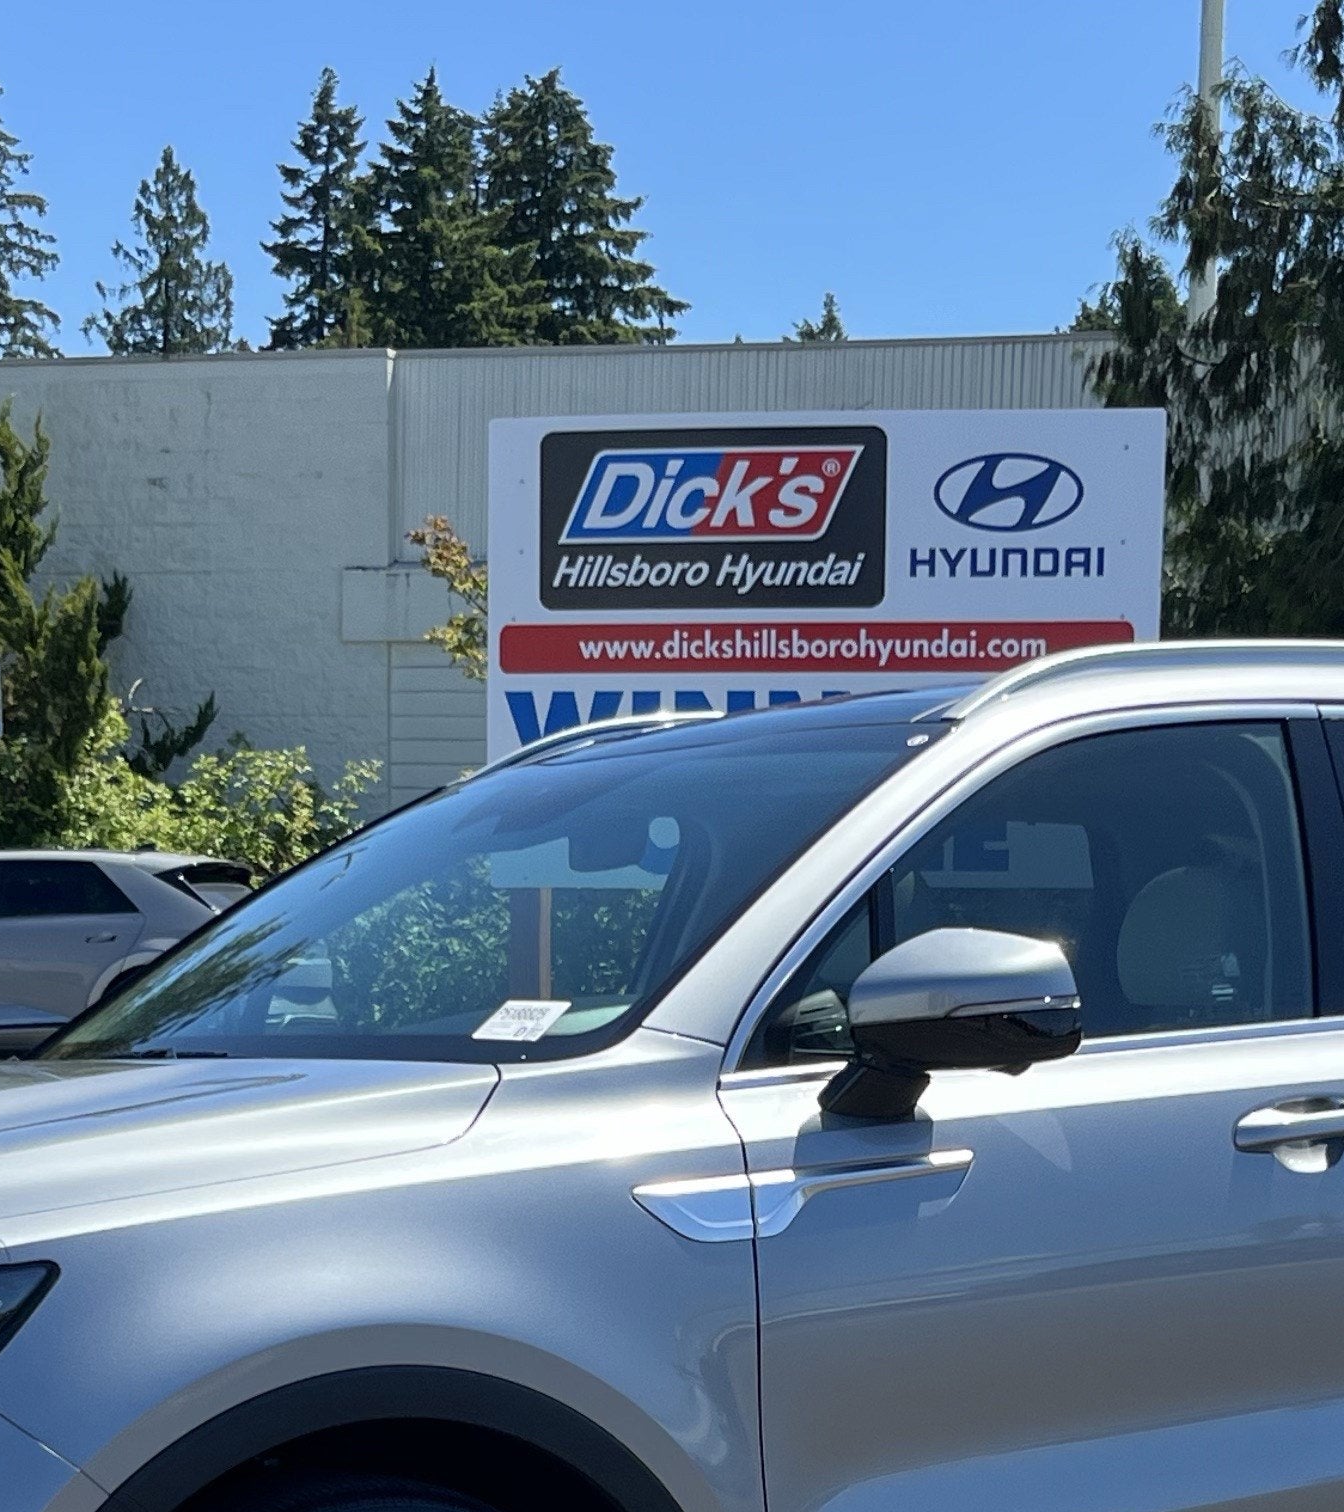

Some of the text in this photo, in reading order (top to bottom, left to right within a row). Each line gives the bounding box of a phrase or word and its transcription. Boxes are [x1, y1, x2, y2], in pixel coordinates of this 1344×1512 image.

[581, 456, 824, 530] Dick's
[552, 551, 866, 594] Hillsboro Hyundai
[909, 546, 1105, 578] HYUNDAI
[578, 628, 1048, 667] www.dickshillsborohyundai.com
